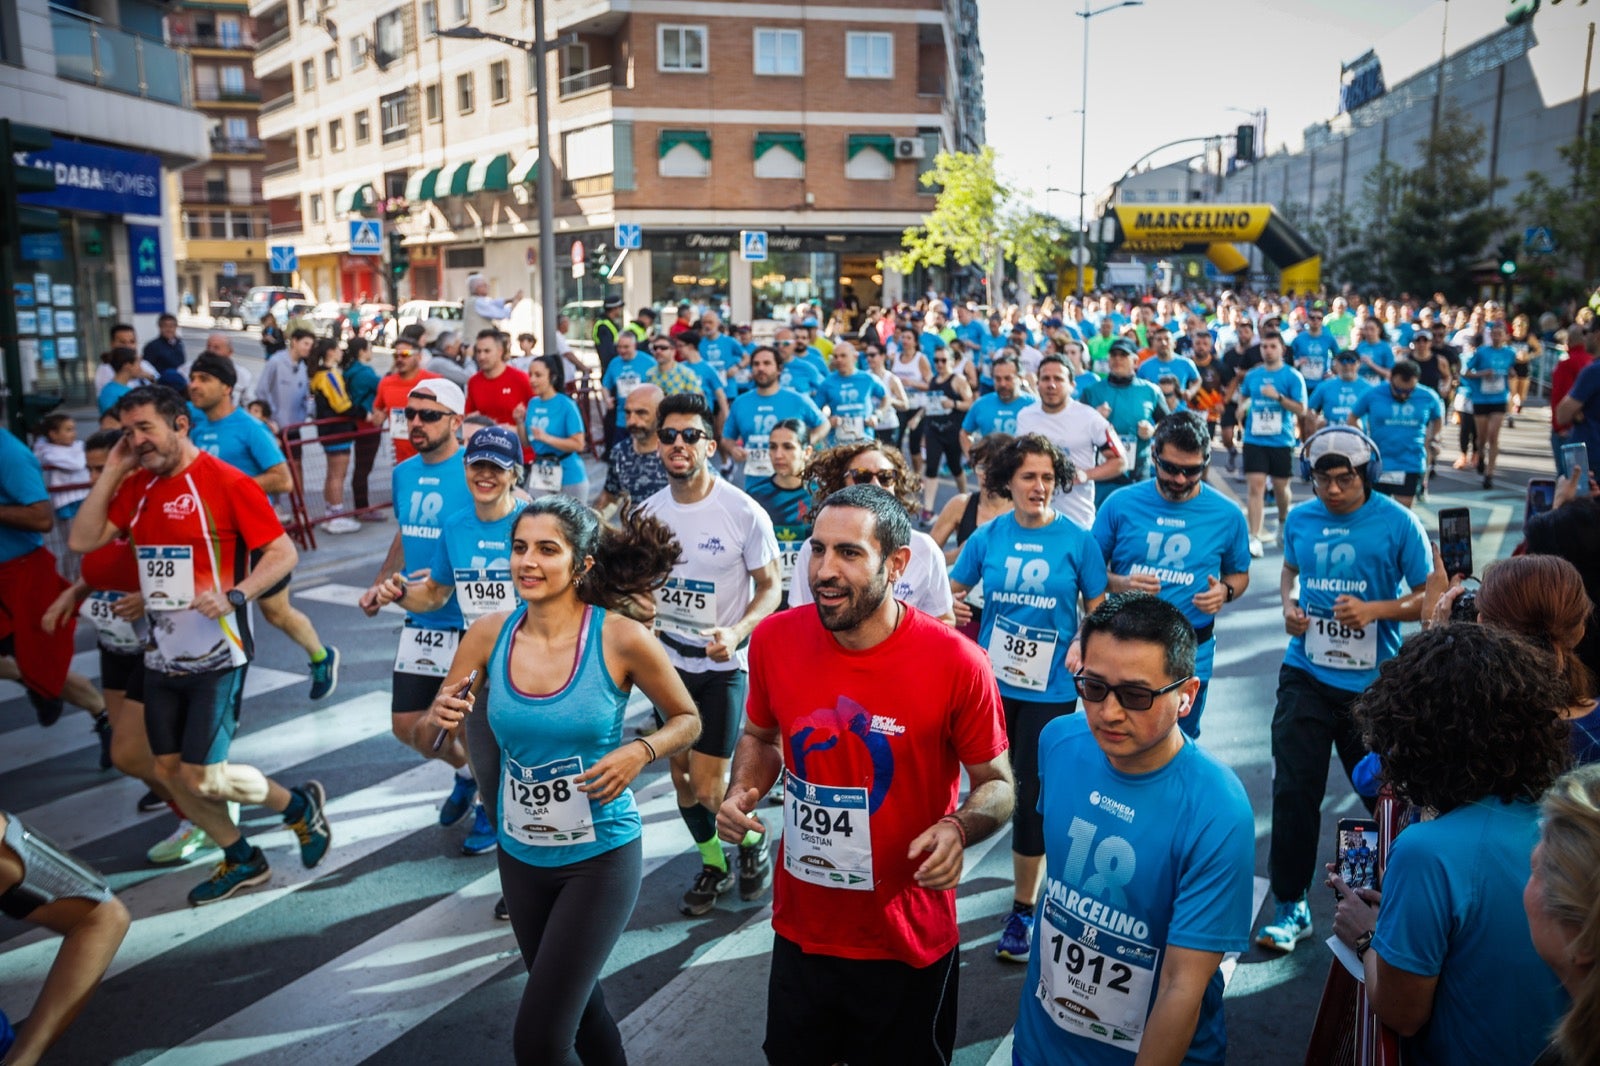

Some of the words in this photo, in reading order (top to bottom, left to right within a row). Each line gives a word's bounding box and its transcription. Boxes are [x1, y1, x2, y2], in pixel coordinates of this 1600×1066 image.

[1134, 211, 1251, 230] MARCELINO
[409, 490, 444, 526] 18
[1145, 530, 1192, 570] 18
[147, 561, 175, 577] 928
[1004, 555, 1050, 594] 18
[464, 582, 506, 600] 1948
[1306, 576, 1368, 593] MARCELINO
[660, 587, 706, 610] 2475
[991, 590, 1057, 610] MARCELINO
[414, 630, 444, 648] 442
[1315, 619, 1365, 640] 1685
[1003, 634, 1038, 658] 383
[510, 778, 572, 807] 1298
[524, 807, 549, 816] CLARA
[1101, 795, 1136, 817] OXIMESA
[791, 799, 853, 837] 1294
[801, 832, 833, 847] CRISTIAN
[1063, 816, 1137, 910] 18
[1048, 877, 1150, 941] MARCELINO
[1051, 933, 1134, 995] 1912
[1067, 974, 1098, 996] WEILEI
